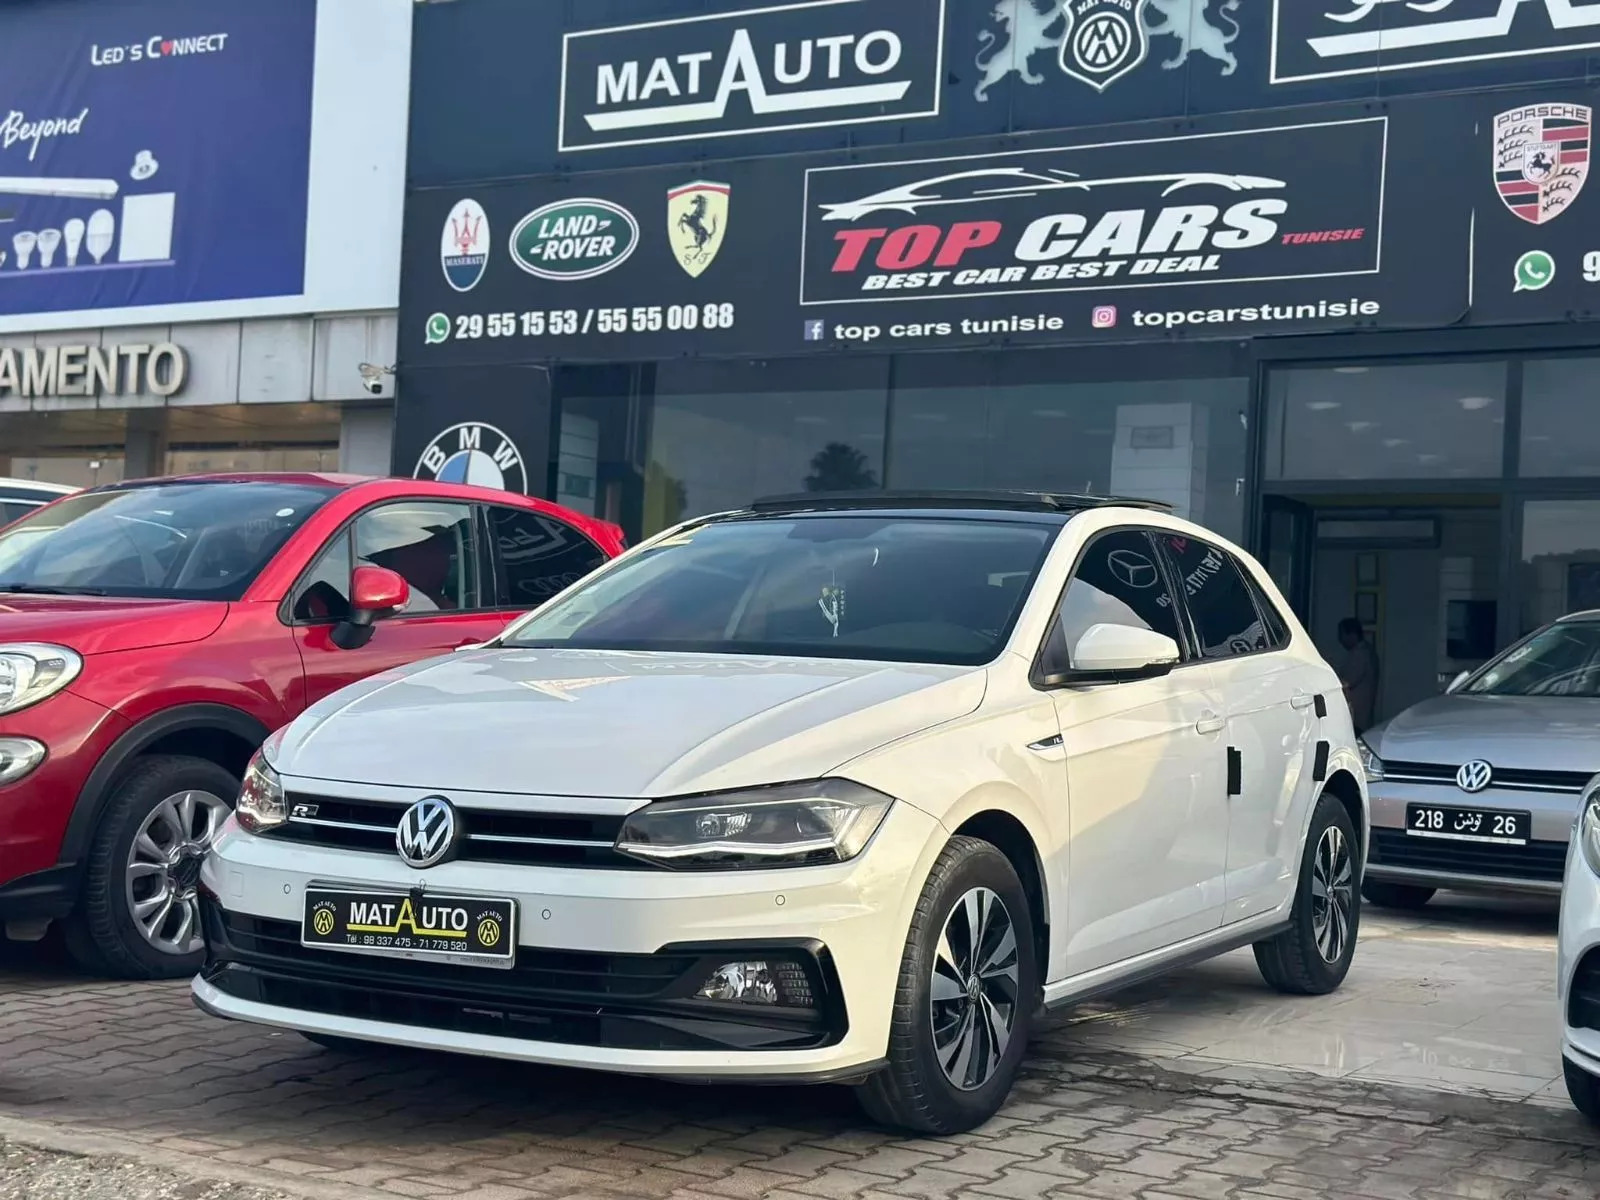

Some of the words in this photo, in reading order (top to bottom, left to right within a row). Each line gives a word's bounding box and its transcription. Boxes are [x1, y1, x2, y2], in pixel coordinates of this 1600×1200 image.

[1498, 106, 1588, 128] PORSCHE
[0, 108, 89, 161] Beyond
[538, 215, 598, 238] LAND
[831, 221, 1002, 272] TOP
[1014, 199, 1288, 261] CARS
[1281, 228, 1365, 245] TUNISIE
[542, 236, 615, 260] ROVER
[861, 271, 950, 291] BEST
[952, 266, 1027, 286] CAR
[1030, 260, 1128, 281] BEST
[1128, 254, 1222, 276] DEAL
[455, 315, 483, 339] 29
[487, 313, 516, 336] 55
[520, 311, 545, 335] 15
[549, 309, 578, 334] 53
[581, 309, 594, 333] /
[597, 308, 629, 333] 55
[632, 306, 663, 331] 55
[666, 304, 699, 330] 00
[702, 302, 735, 329] 88
[834, 324, 881, 342] top
[889, 320, 952, 338] cars
[960, 314, 1064, 334] tunisie
[1132, 298, 1381, 328] topcarstunisie
[0, 342, 184, 397] AMENTO
[423, 426, 518, 474] BMW
[1415, 810, 1444, 829] 218
[1493, 815, 1516, 835] 26
[376, 936, 393, 946] 337
[395, 938, 411, 948] 475
[420, 939, 429, 949] 71
[432, 940, 449, 950] 779
[450, 941, 468, 951] 520
